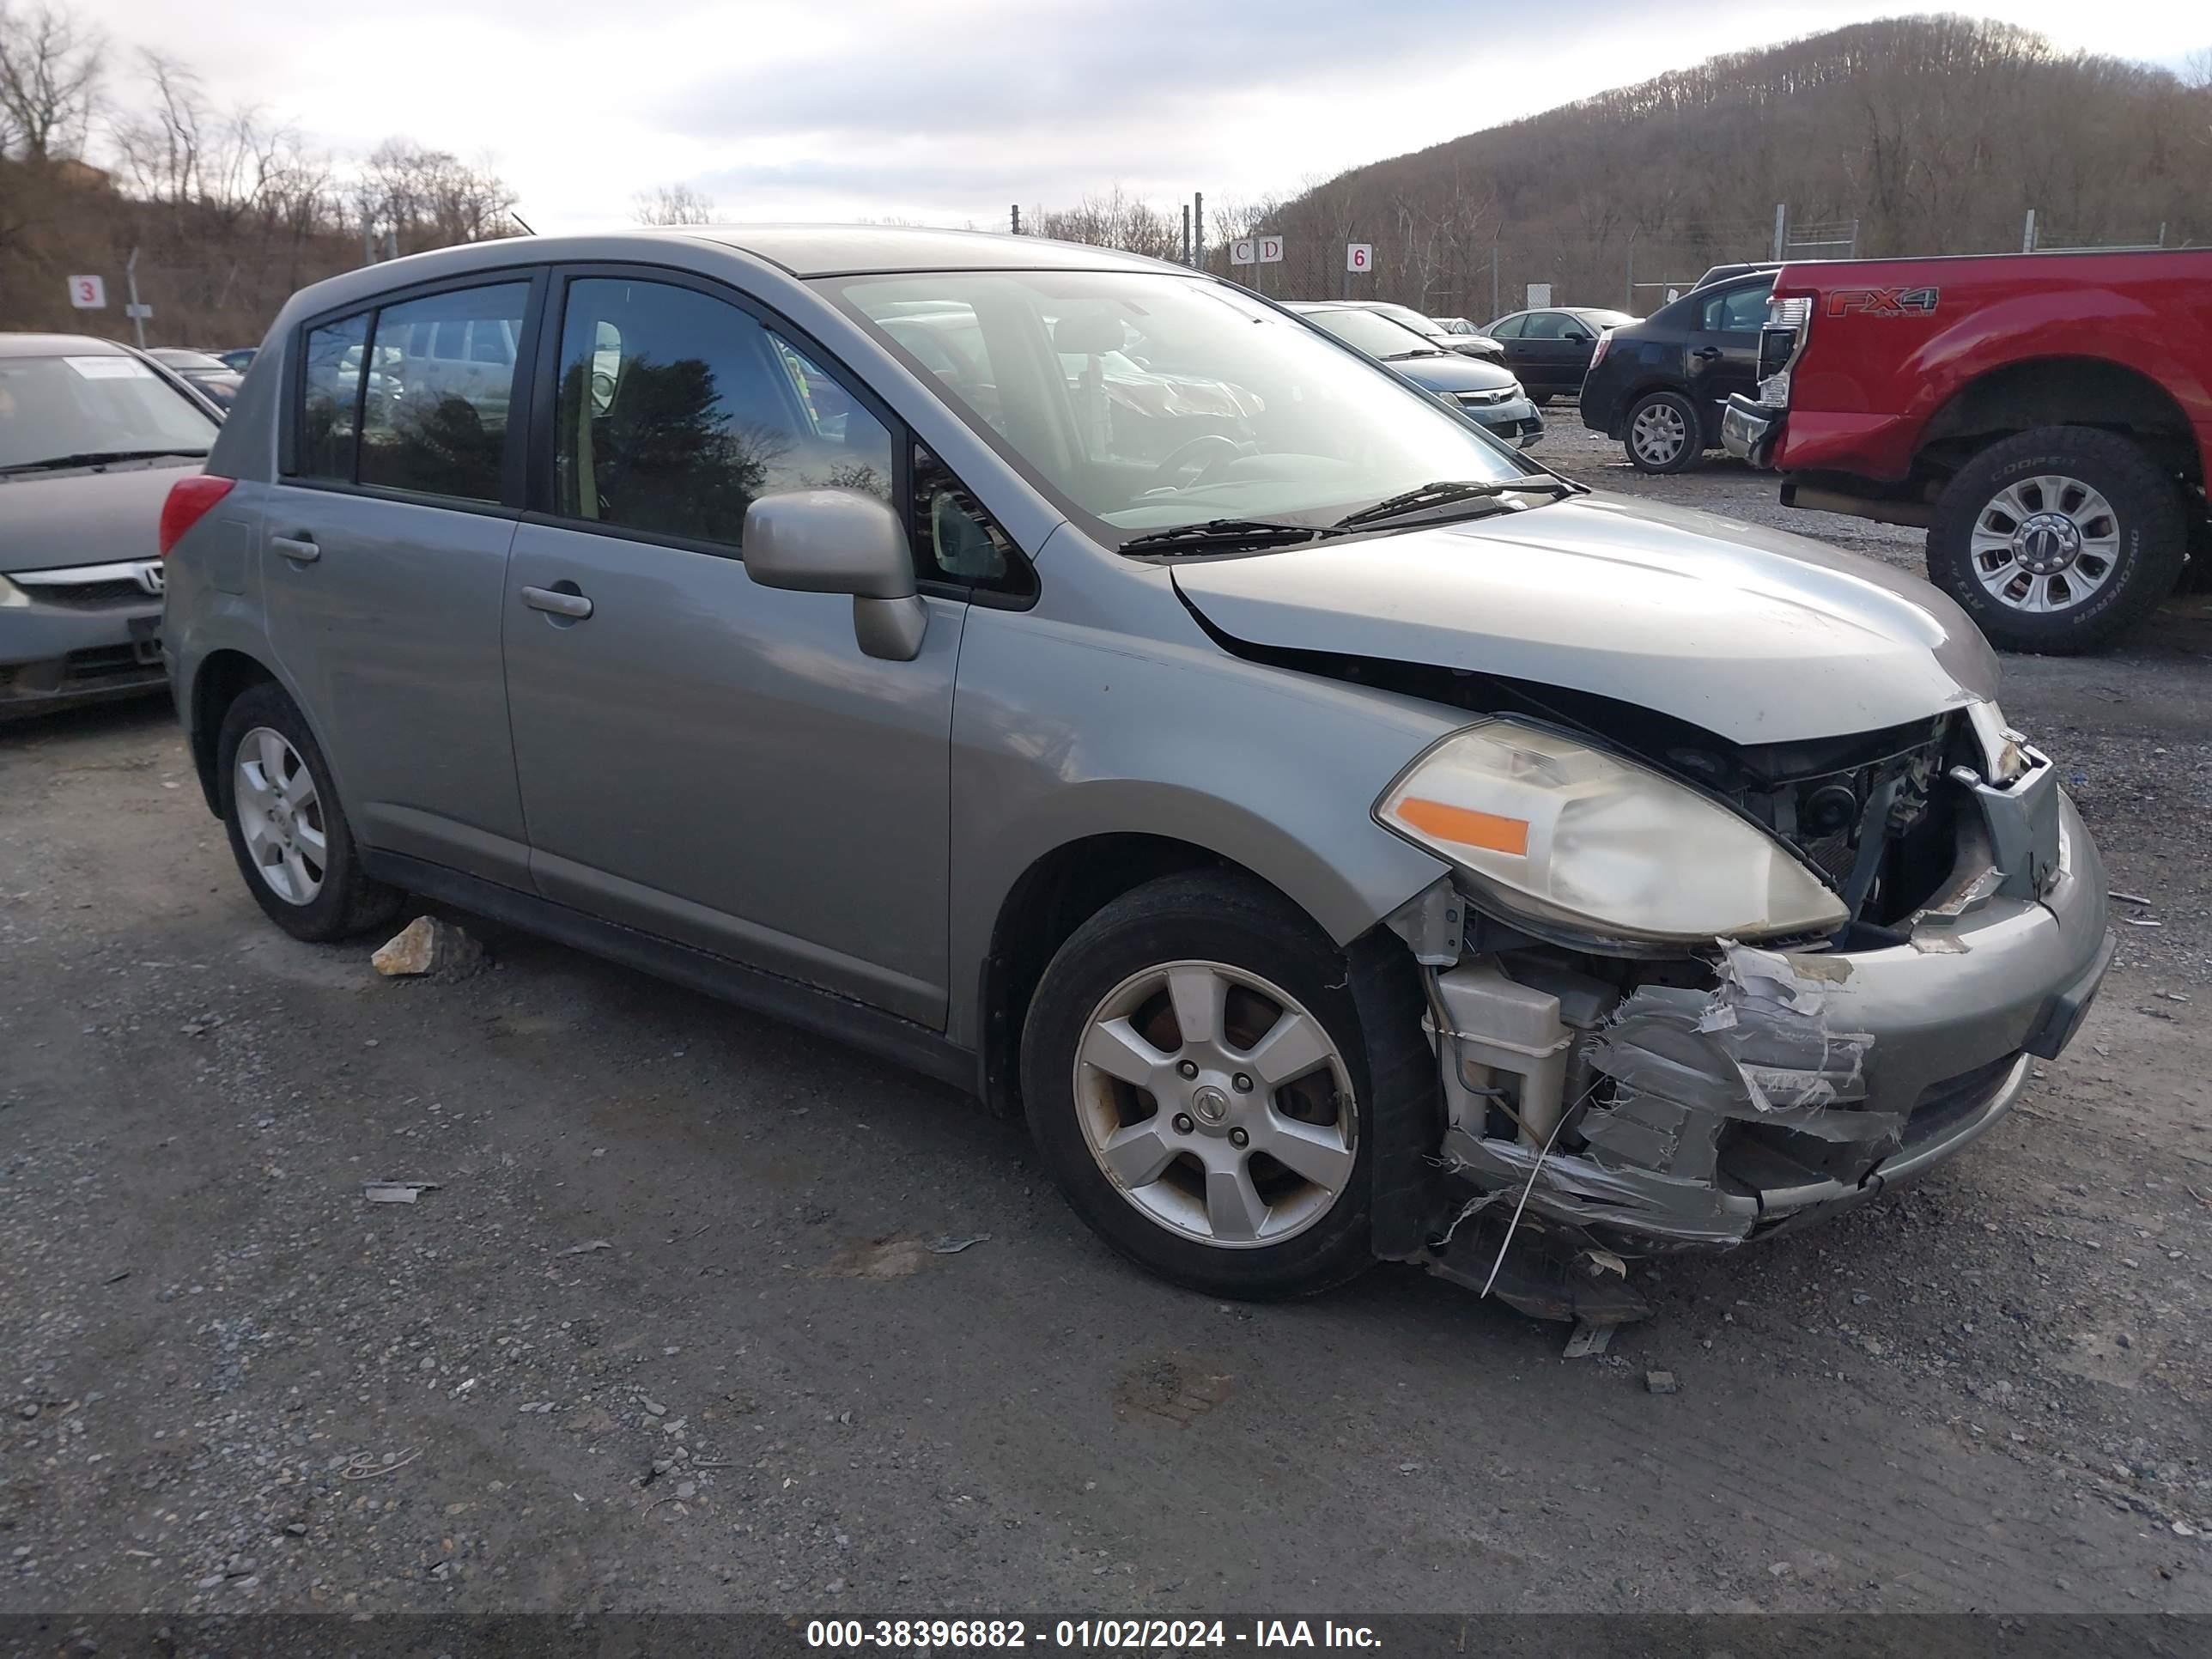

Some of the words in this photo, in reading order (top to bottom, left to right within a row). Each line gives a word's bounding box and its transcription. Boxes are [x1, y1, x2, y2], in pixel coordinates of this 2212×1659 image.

[1236, 242, 1249, 260] C
[1263, 240, 1279, 258] D
[1353, 248, 1365, 267] 6
[79, 282, 95, 302] 3
[1826, 286, 1940, 318] FX4
[2073, 529, 2140, 625] DISCOVERER
